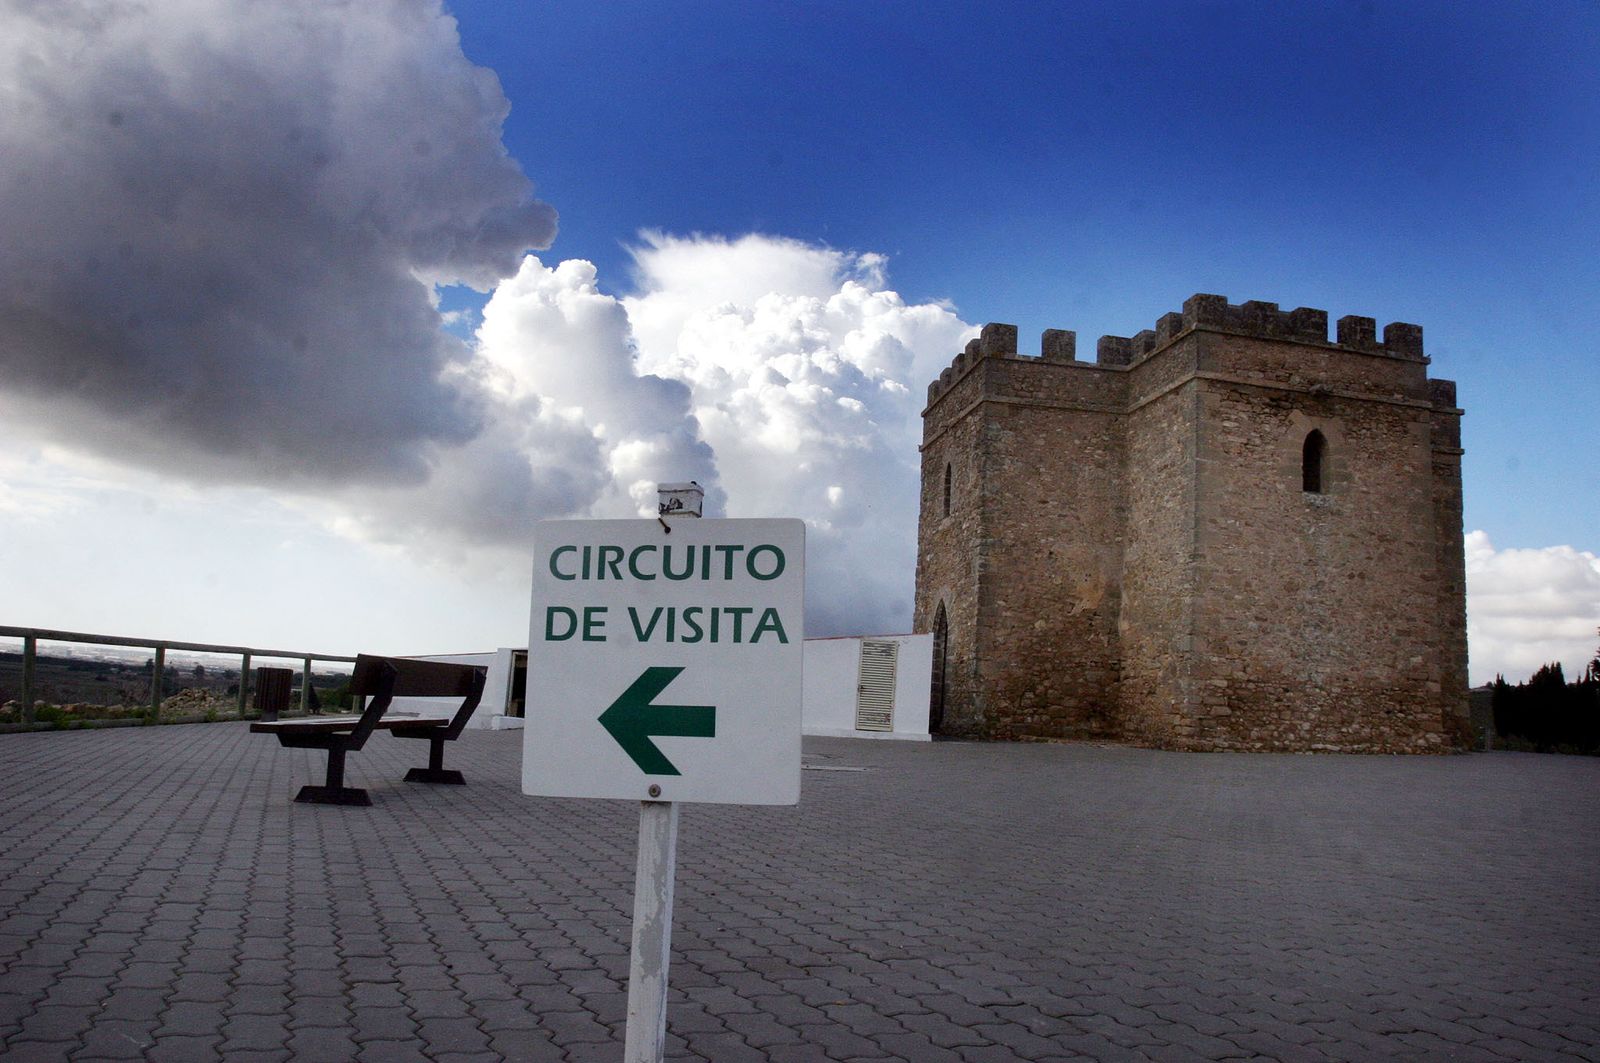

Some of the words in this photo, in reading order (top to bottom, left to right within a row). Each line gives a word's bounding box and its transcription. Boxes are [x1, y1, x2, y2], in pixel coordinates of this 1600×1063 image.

[549, 544, 786, 581] CIRCUITO
[545, 606, 608, 642] DE
[627, 606, 789, 644] VISITA
